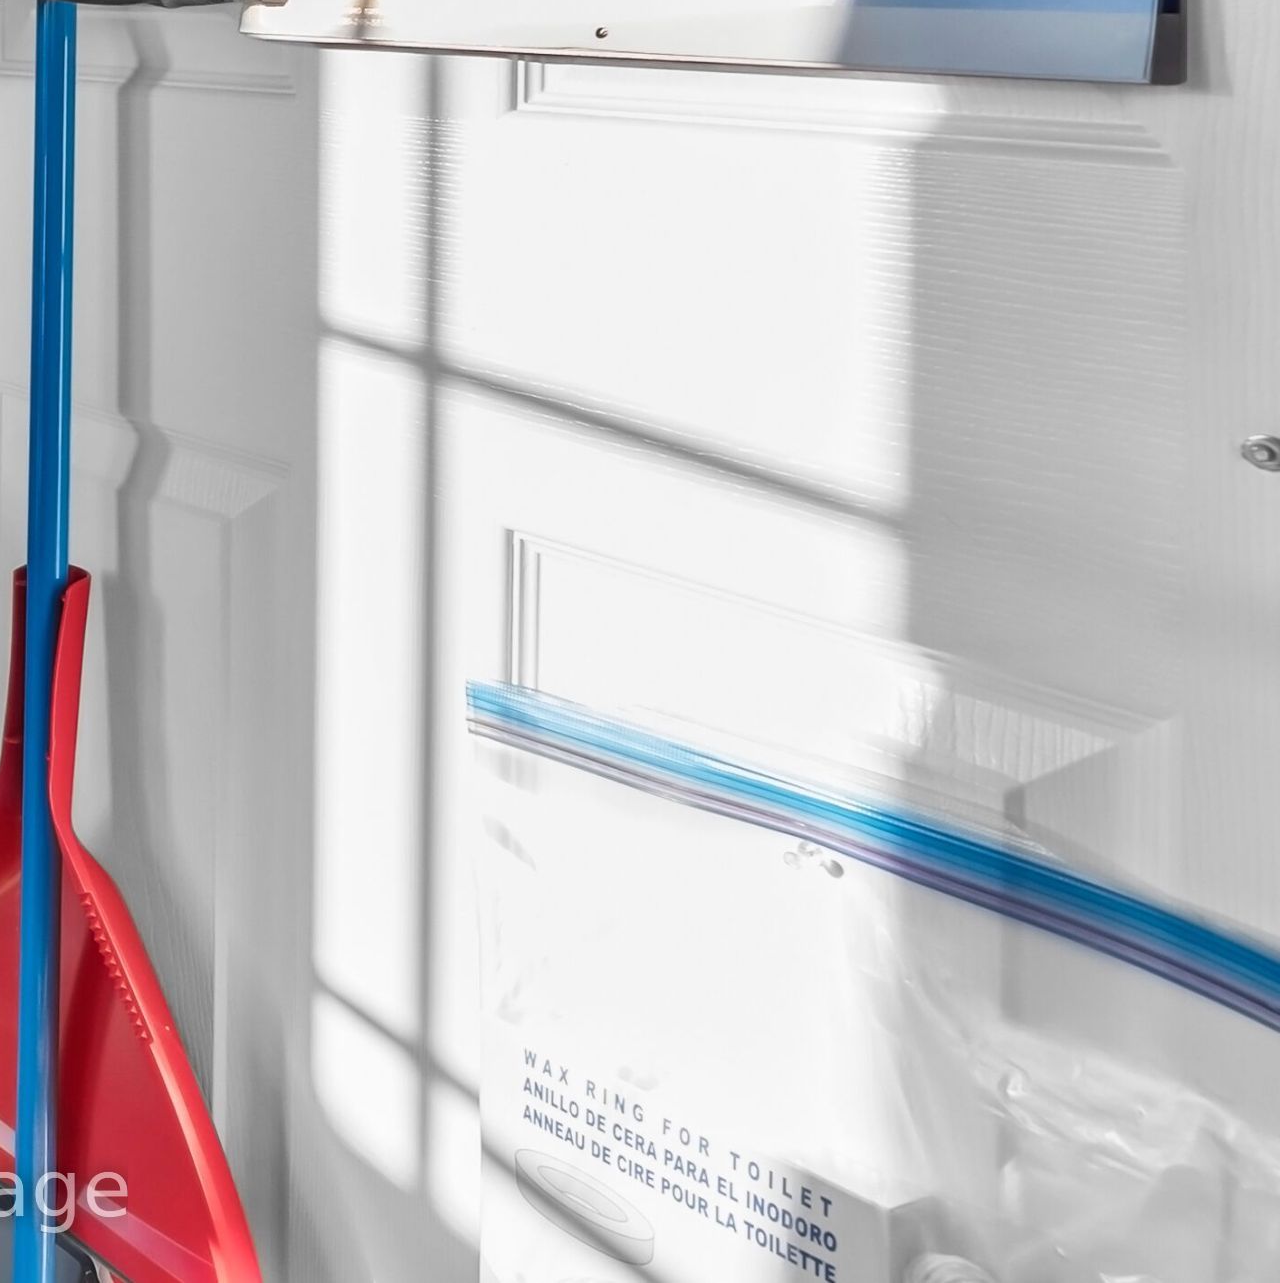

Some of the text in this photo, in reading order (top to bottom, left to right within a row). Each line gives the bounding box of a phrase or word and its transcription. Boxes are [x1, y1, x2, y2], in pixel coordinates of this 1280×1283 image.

[523, 1076, 838, 1254] ANILLO DE CERA PARA EL INODORO
[523, 1105, 837, 1283] ANNEAU DE CIRE POUR LA TOILETTE
[524, 1047, 833, 1218] WAX RING FOR TOILET
